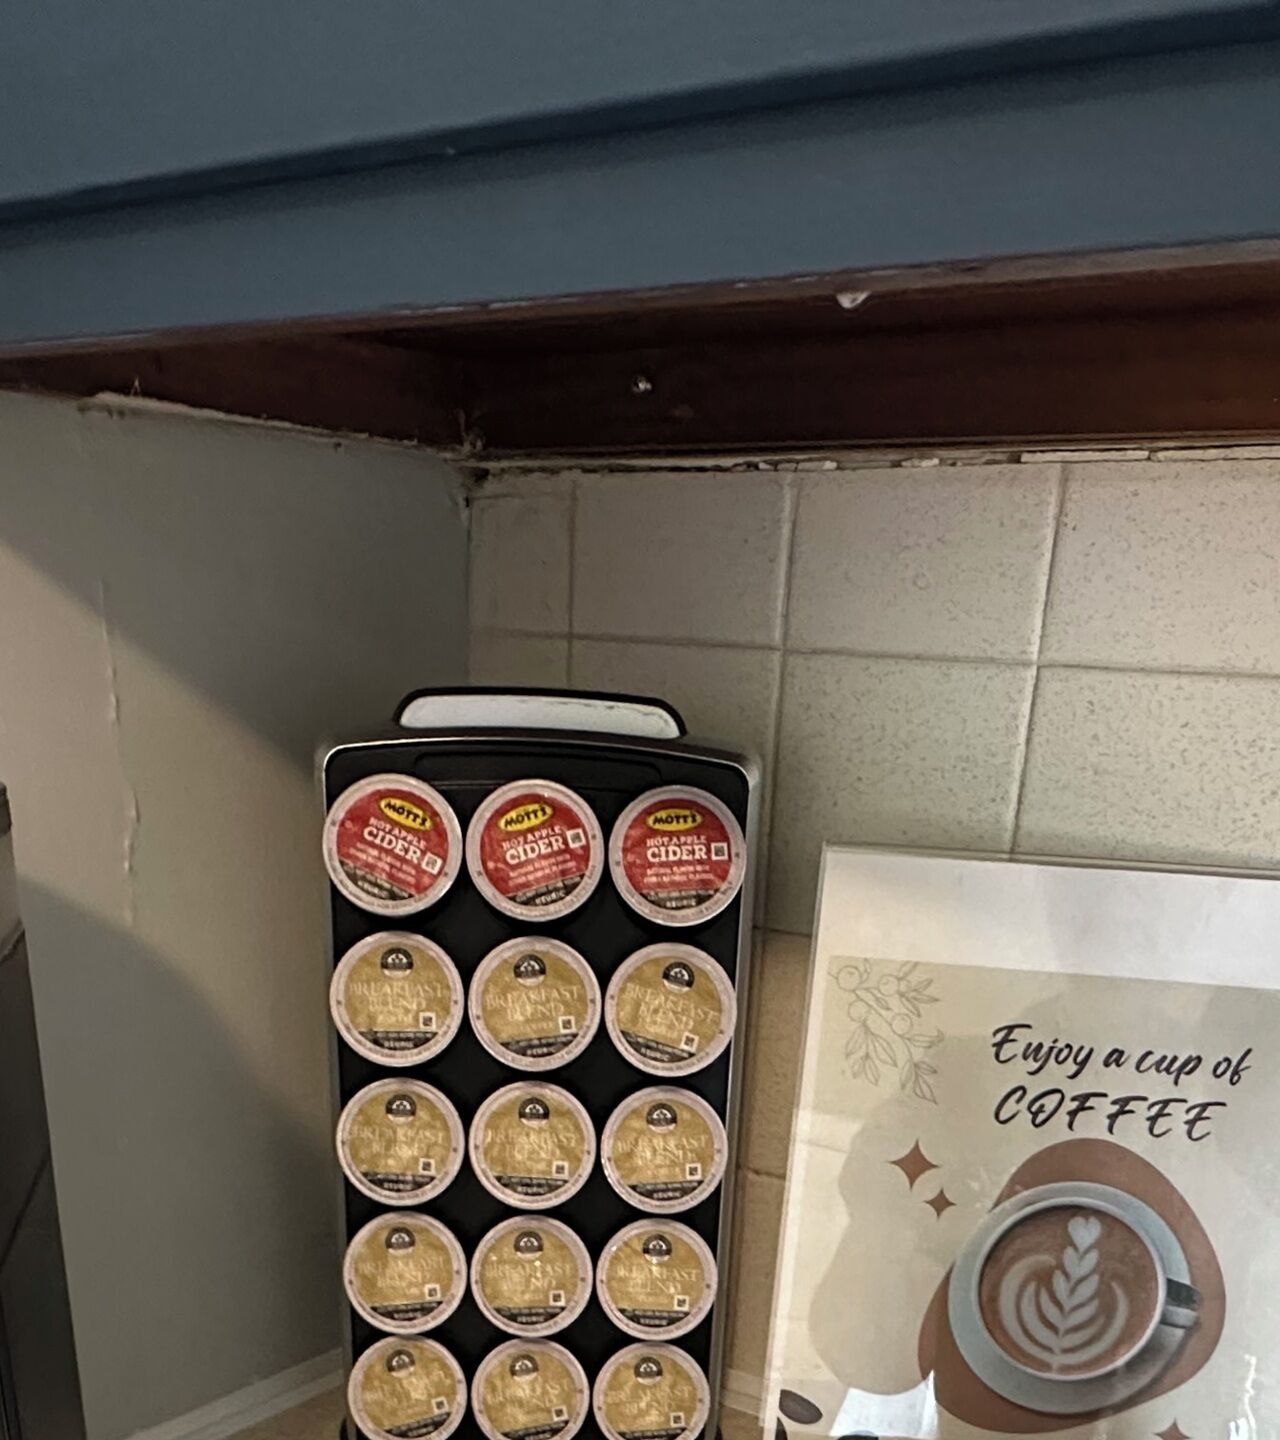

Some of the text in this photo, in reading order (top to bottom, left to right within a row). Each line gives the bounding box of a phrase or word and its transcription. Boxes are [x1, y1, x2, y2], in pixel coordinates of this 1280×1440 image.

[384, 801, 428, 827] MOTT'S
[503, 803, 549, 829] MOTT'S
[652, 810, 698, 826] MOTT'S
[362, 826, 422, 864] CIDER
[505, 836, 565, 865] CIDER
[646, 844, 708, 862] CIDER
[991, 1023, 1253, 1087] Enjoy a cup of
[993, 1084, 1227, 1142] COFFEE
